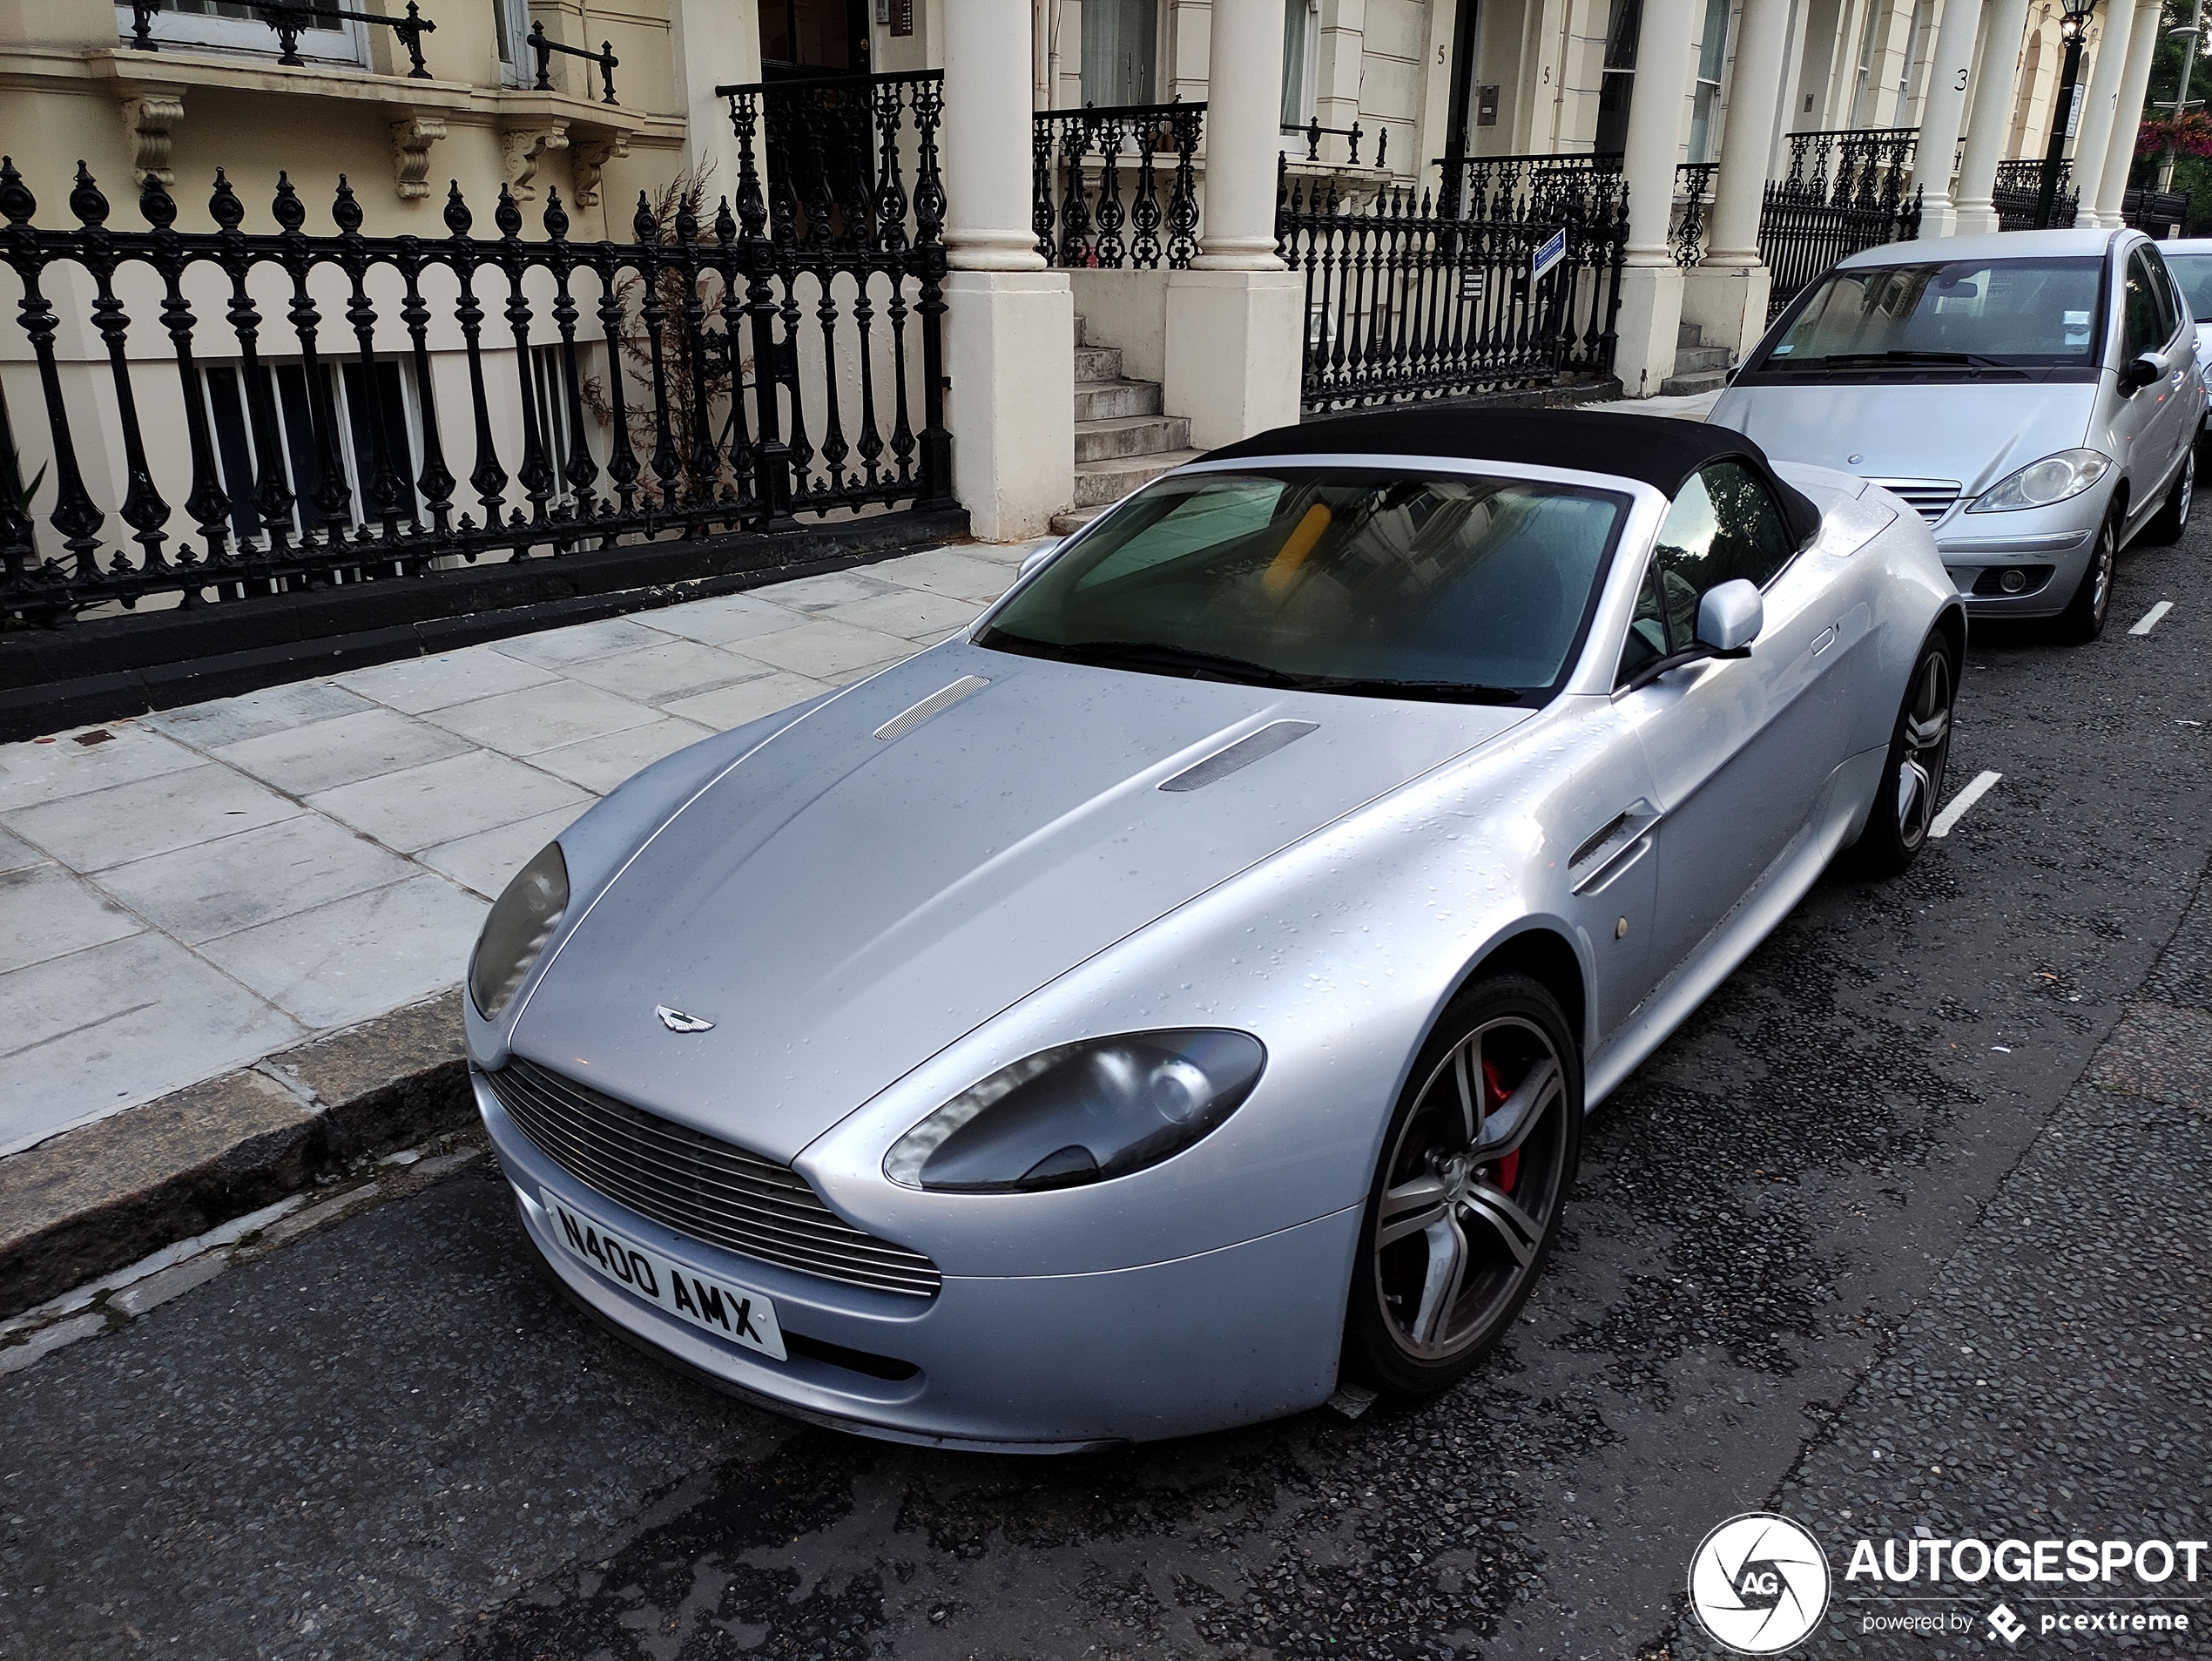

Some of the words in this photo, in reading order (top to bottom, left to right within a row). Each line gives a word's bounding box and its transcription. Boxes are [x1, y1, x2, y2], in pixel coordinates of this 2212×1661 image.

[1438, 44, 1446, 65] 5
[1543, 65, 1551, 85] 5
[1953, 68, 1969, 91] 3
[2111, 92, 2118, 111] 1
[556, 1205, 660, 1299] N400
[671, 1269, 764, 1346] AMX
